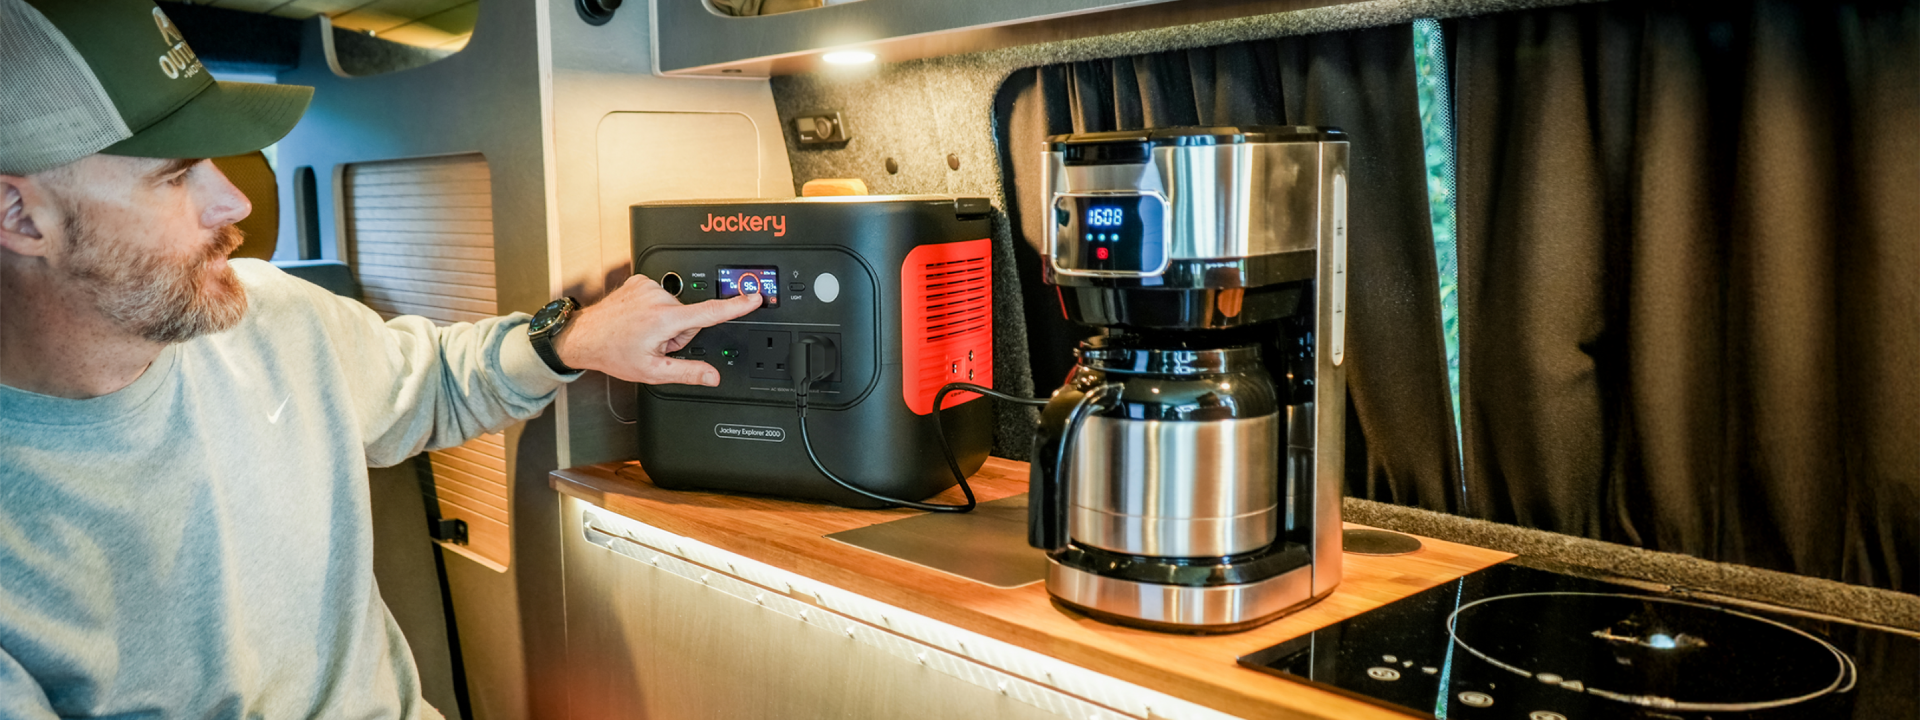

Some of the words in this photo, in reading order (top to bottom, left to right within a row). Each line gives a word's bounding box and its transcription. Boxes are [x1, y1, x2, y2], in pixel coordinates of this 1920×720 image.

[700, 212, 787, 237] Jackery
[1087, 208, 1123, 226] 16:08
[719, 427, 741, 436] Jackery
[741, 428, 765, 437] Explorer
[765, 430, 781, 438] 2000
